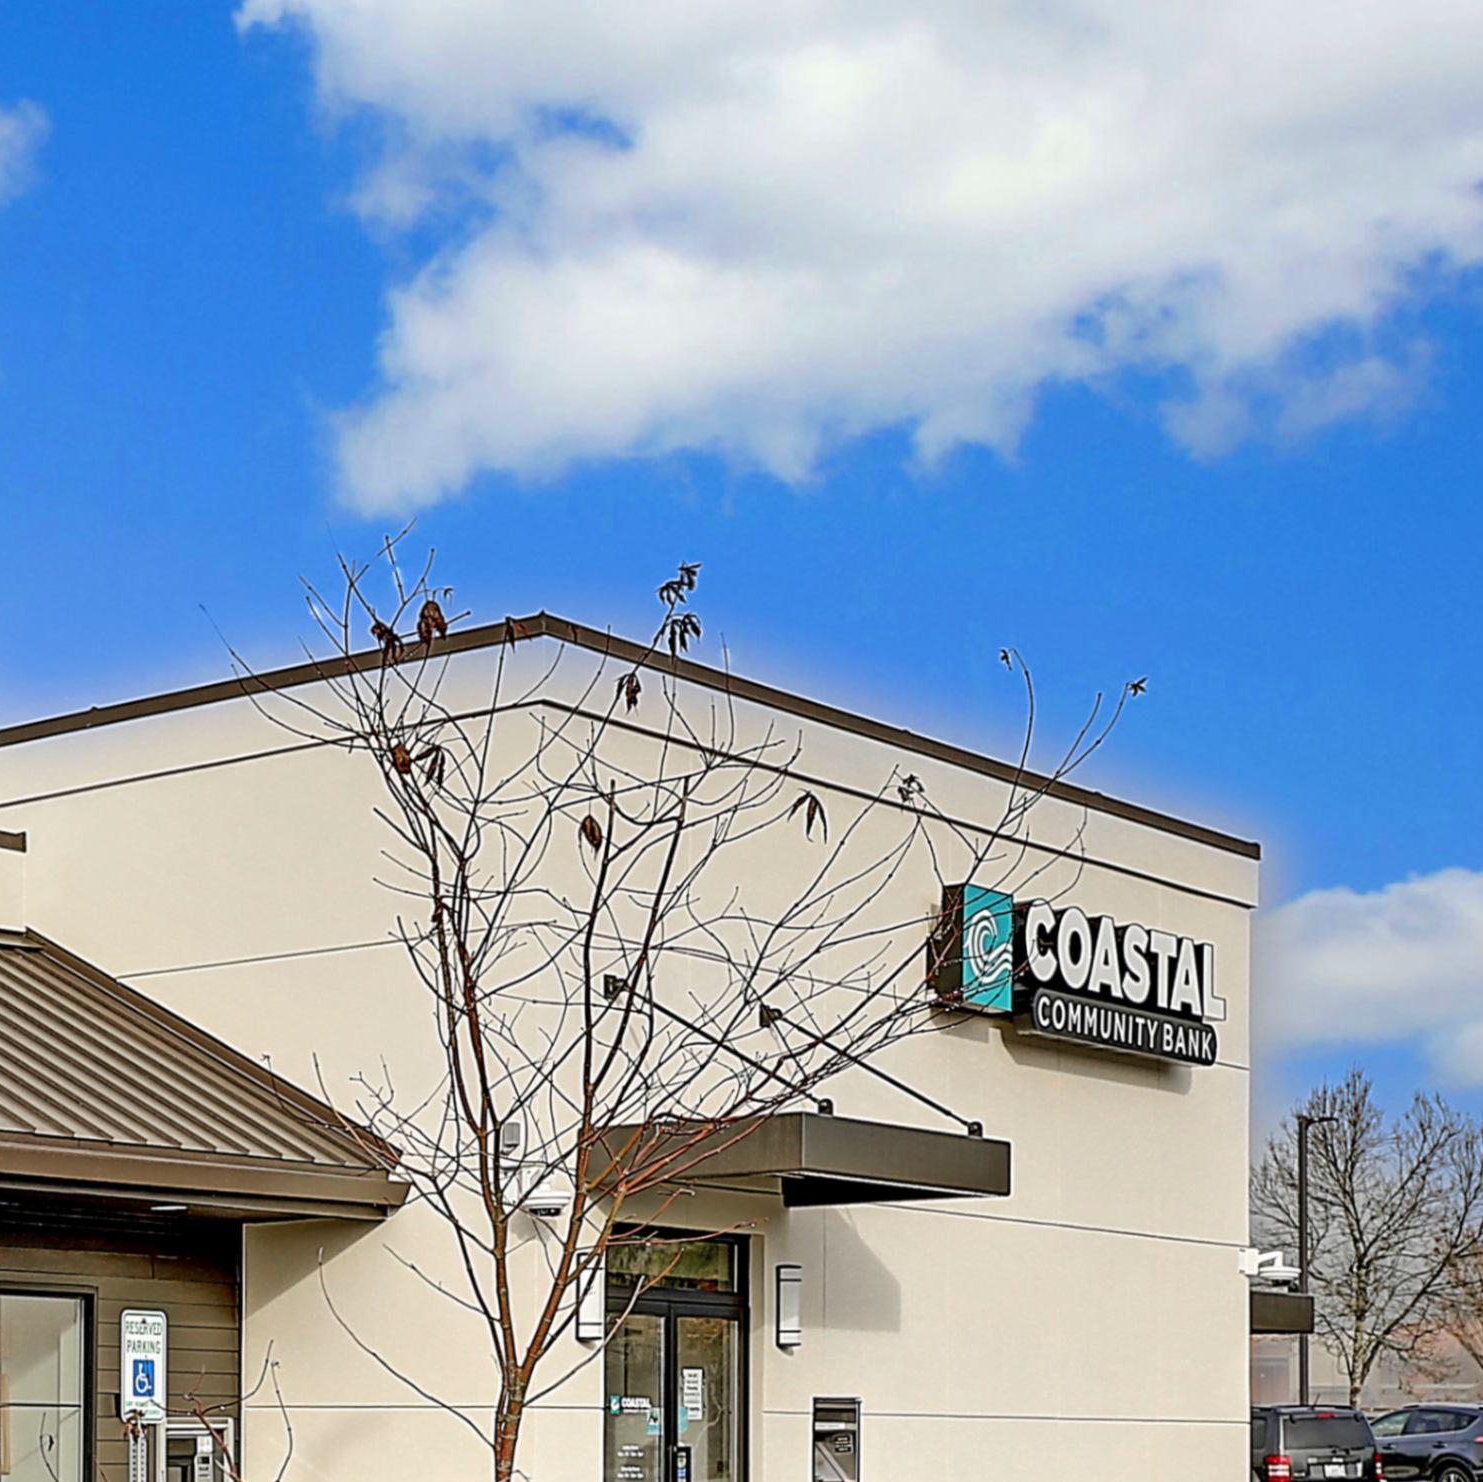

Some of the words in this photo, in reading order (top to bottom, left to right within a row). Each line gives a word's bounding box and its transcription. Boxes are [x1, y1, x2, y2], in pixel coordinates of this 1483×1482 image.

[1025, 898, 1226, 1021] COASTAL
[1037, 996, 1157, 1050] COMMUNITY
[1163, 1023, 1214, 1061] BANK
[125, 1321, 162, 1335] RESERVED
[126, 1340, 161, 1354] PARKING
